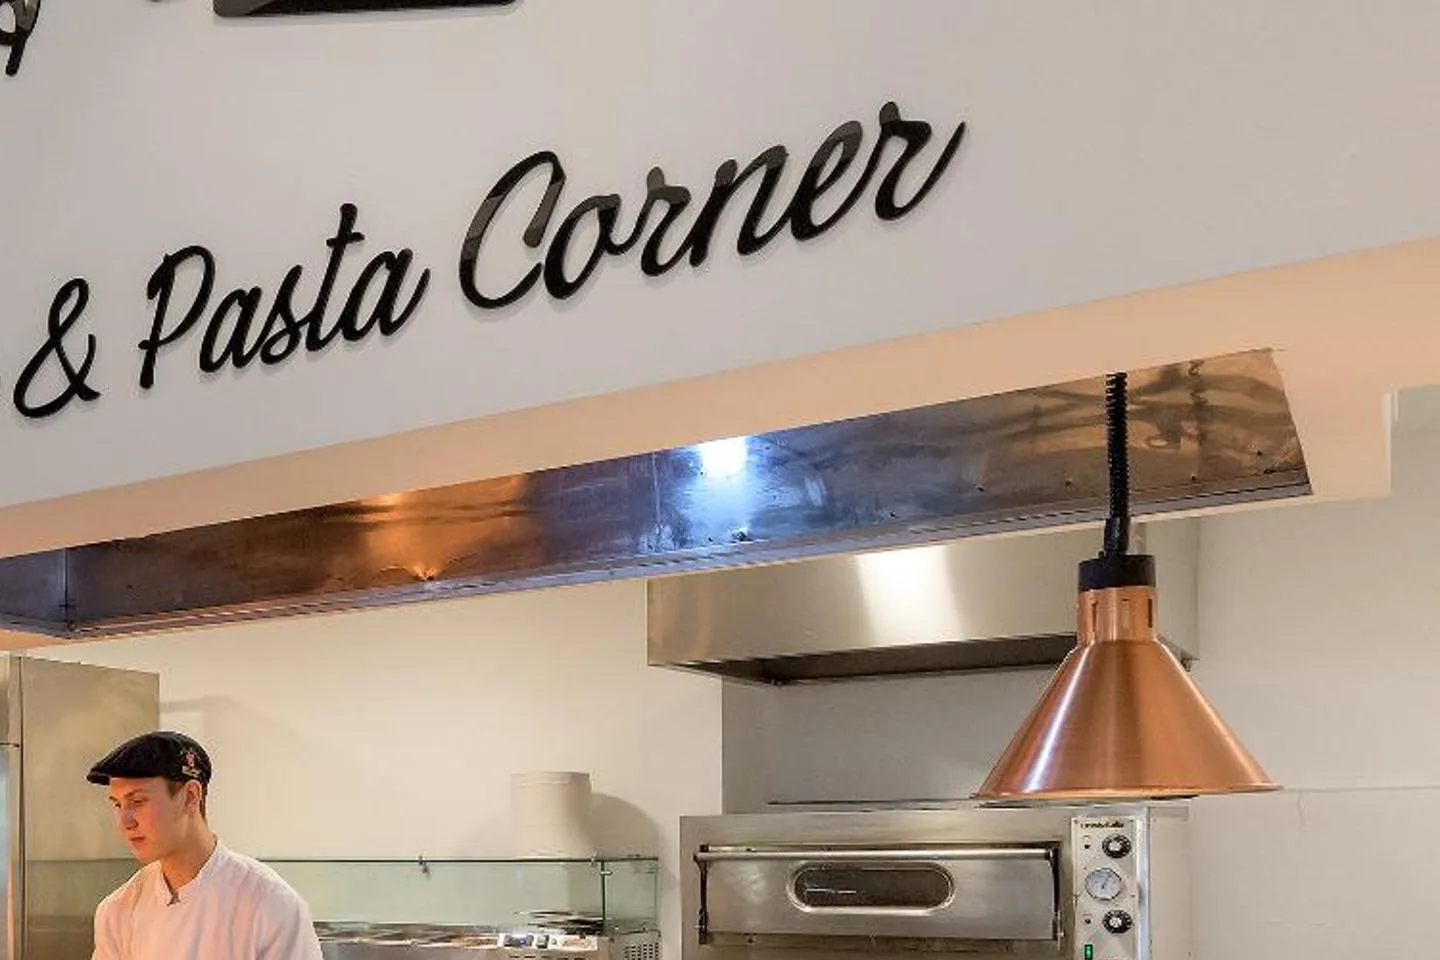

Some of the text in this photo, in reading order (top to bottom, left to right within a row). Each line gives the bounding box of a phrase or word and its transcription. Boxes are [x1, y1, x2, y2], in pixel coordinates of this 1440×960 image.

[12, 277, 102, 420] &
[138, 203, 431, 391] Pasta
[459, 101, 967, 310] Corner
